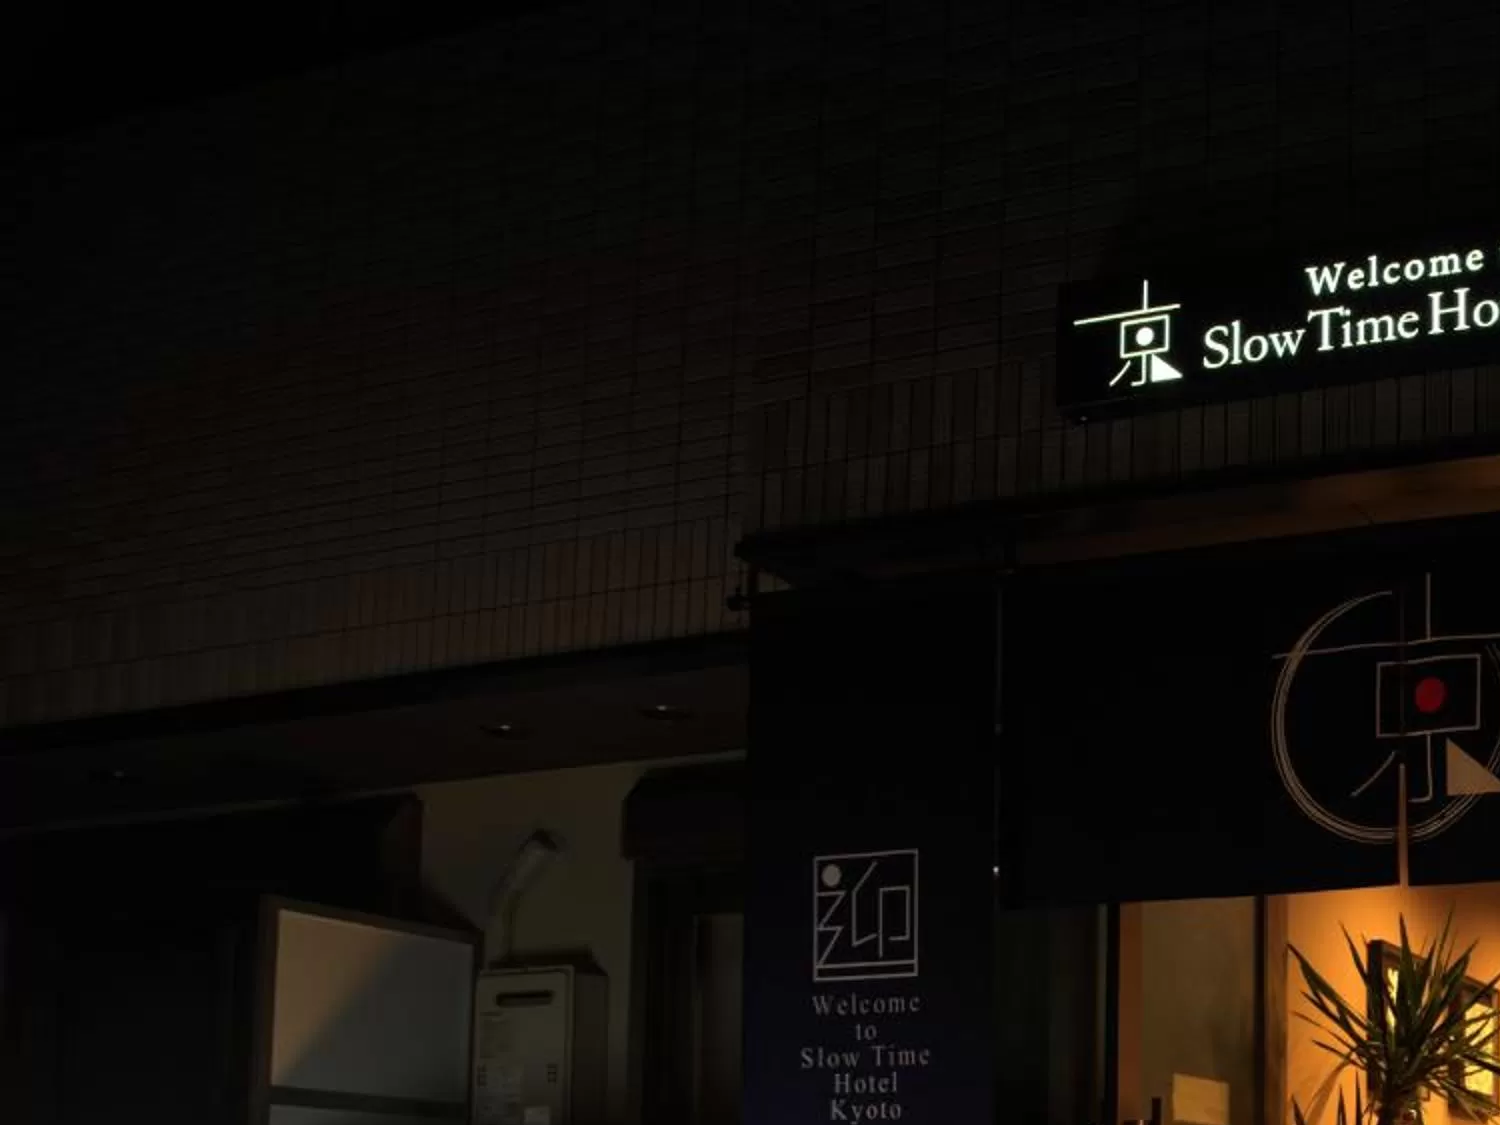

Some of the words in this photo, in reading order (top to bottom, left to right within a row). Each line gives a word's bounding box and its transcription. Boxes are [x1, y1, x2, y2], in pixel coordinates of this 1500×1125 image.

[1304, 249, 1484, 297] Welcome
[812, 993, 920, 1016] Welcome
[855, 1023, 878, 1041] to
[800, 1047, 861, 1069] Slow
[871, 1044, 931, 1067] Time
[833, 1071, 898, 1094] Hotel
